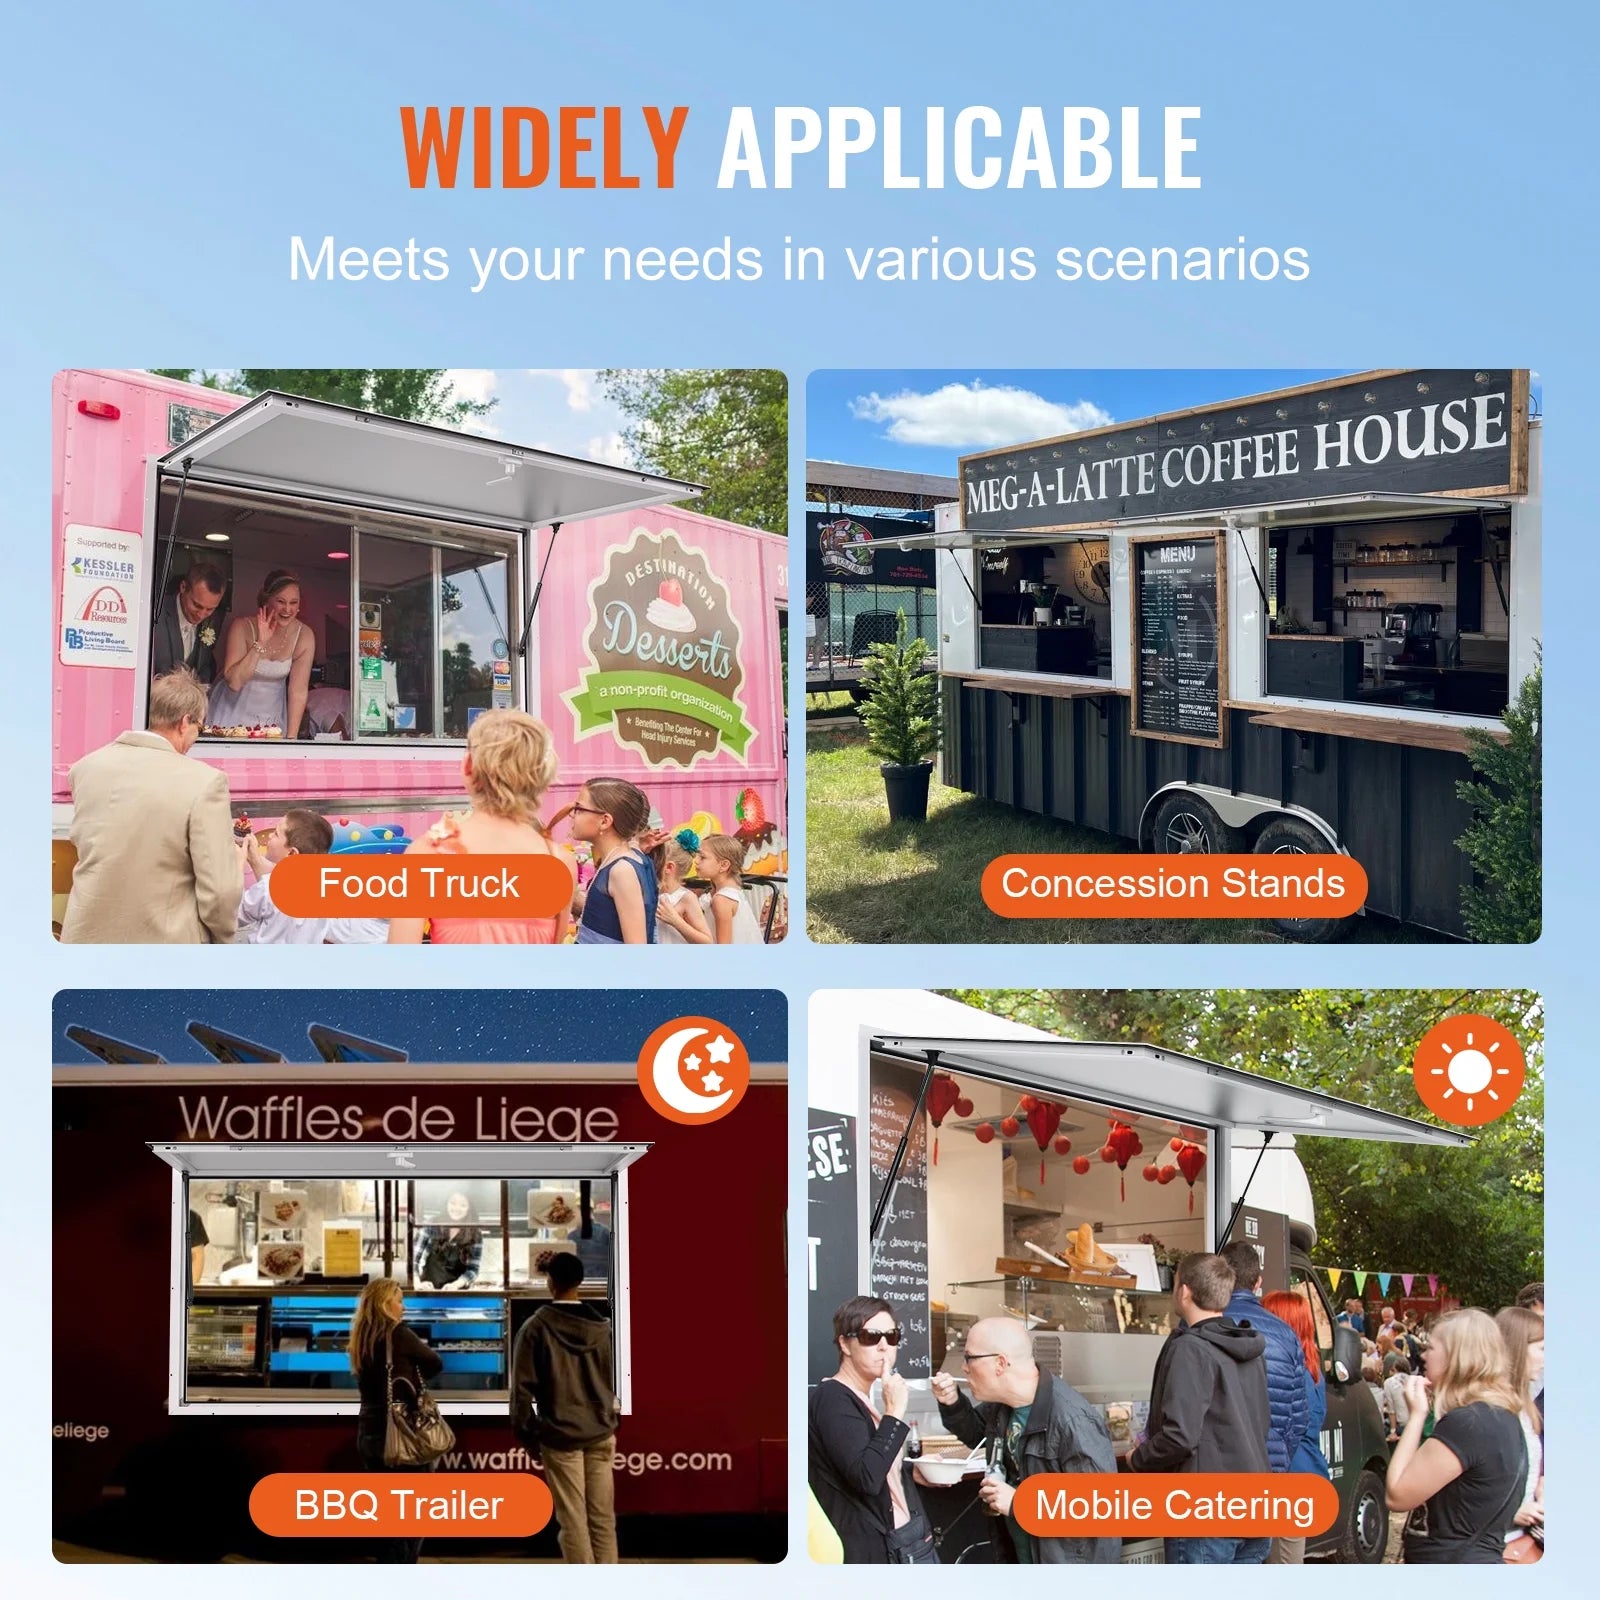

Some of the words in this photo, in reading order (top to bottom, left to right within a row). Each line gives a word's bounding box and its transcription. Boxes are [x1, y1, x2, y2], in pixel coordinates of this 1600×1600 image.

[966, 452, 1156, 515] MEG-A-LATTE
[1160, 429, 1300, 489] COFFEE
[1313, 392, 1508, 472] HOUSE
[77, 537, 117, 550] Supported
[1159, 545, 1197, 563] MENU
[83, 557, 135, 574] KESSLER
[83, 568, 135, 580] FOUNDATION
[624, 557, 716, 611] DESTINATION
[95, 599, 120, 613] DD
[91, 611, 128, 624] Resources
[78, 628, 114, 638] Productive
[84, 635, 105, 645] Living
[105, 637, 126, 645] Board
[602, 599, 733, 680] Desserts
[599, 686, 608, 698] a
[610, 685, 669, 700] non-profit
[670, 690, 734, 724] organization
[634, 716, 664, 732] Benefiting
[664, 721, 676, 732] The
[673, 735, 697, 748] Services
[178, 1095, 364, 1141] Waffles
[380, 1095, 455, 1141] de
[475, 1095, 620, 1142] Liege
